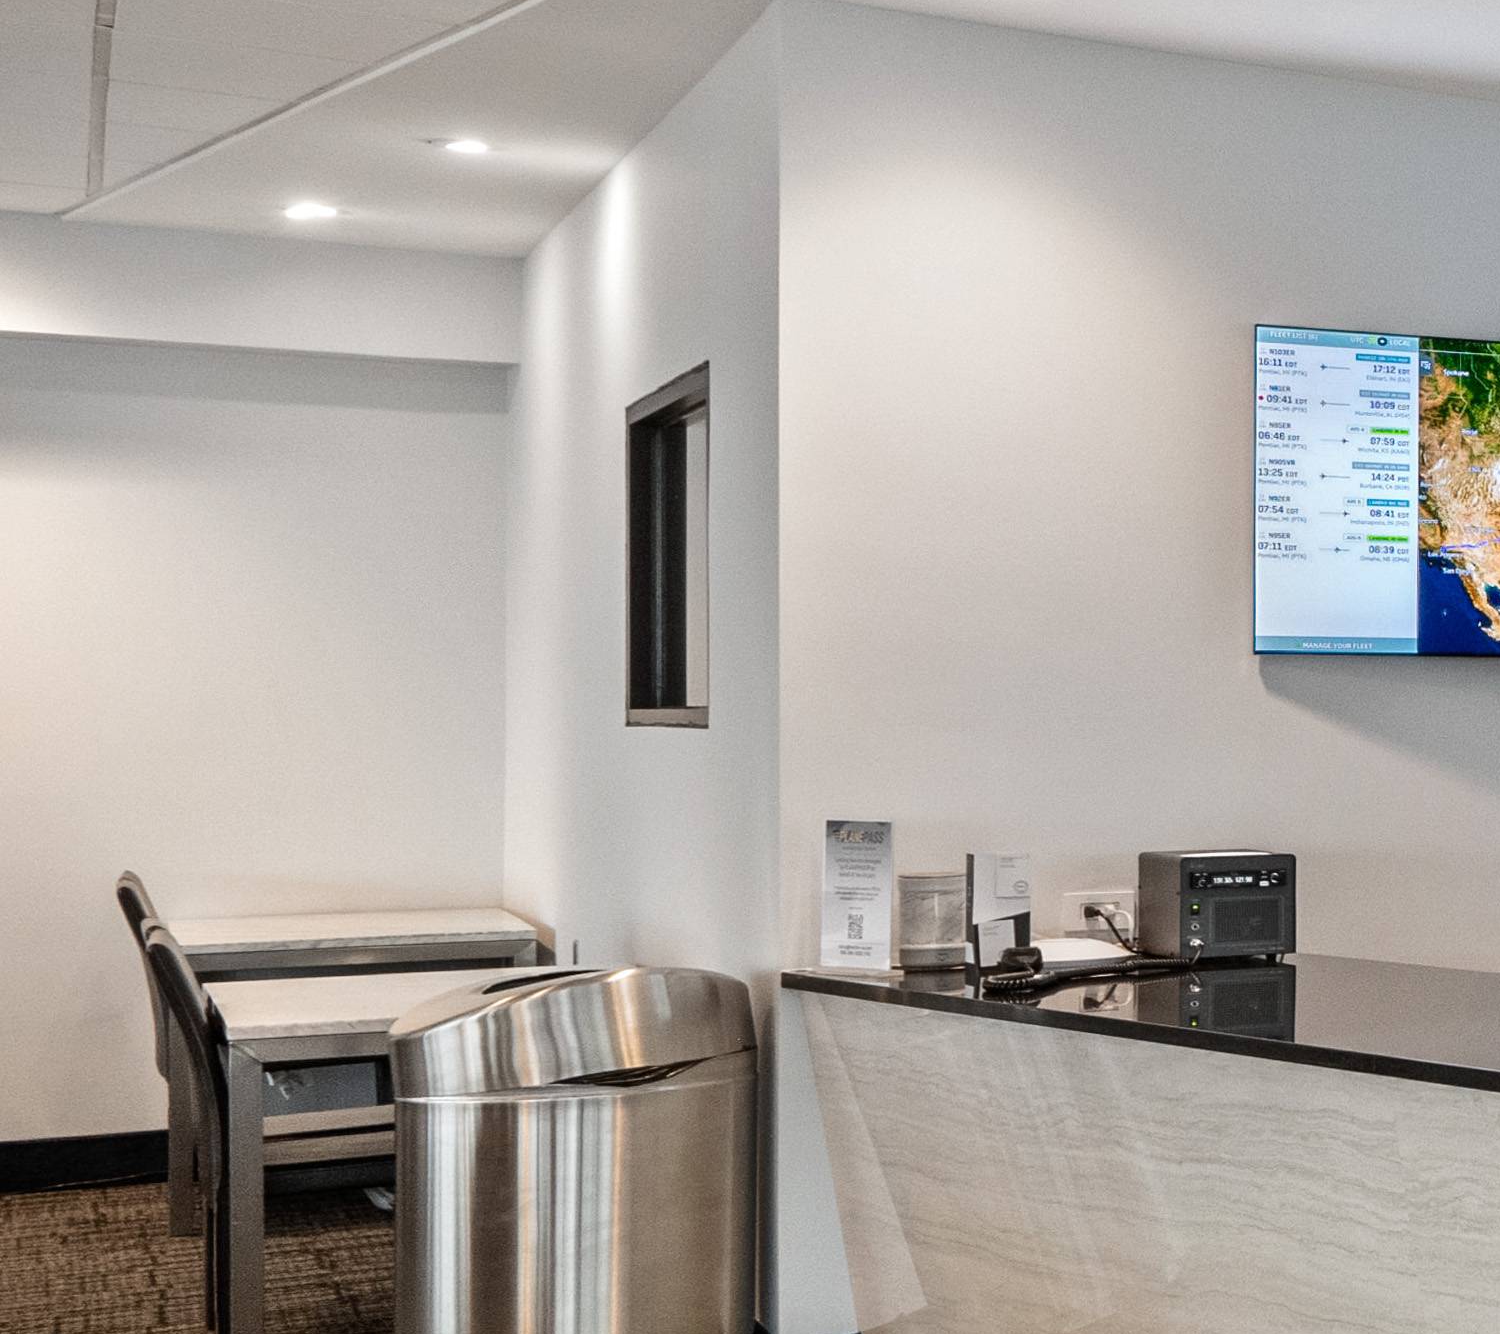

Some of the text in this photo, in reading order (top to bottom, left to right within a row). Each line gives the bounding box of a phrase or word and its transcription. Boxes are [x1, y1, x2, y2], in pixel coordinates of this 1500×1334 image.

[1373, 365, 1396, 374] 17:12
[1266, 395, 1292, 404] 09:41
[1258, 468, 1282, 477] 13:25
[1372, 473, 1395, 481] 14:24
[1258, 505, 1284, 514] 07:54
